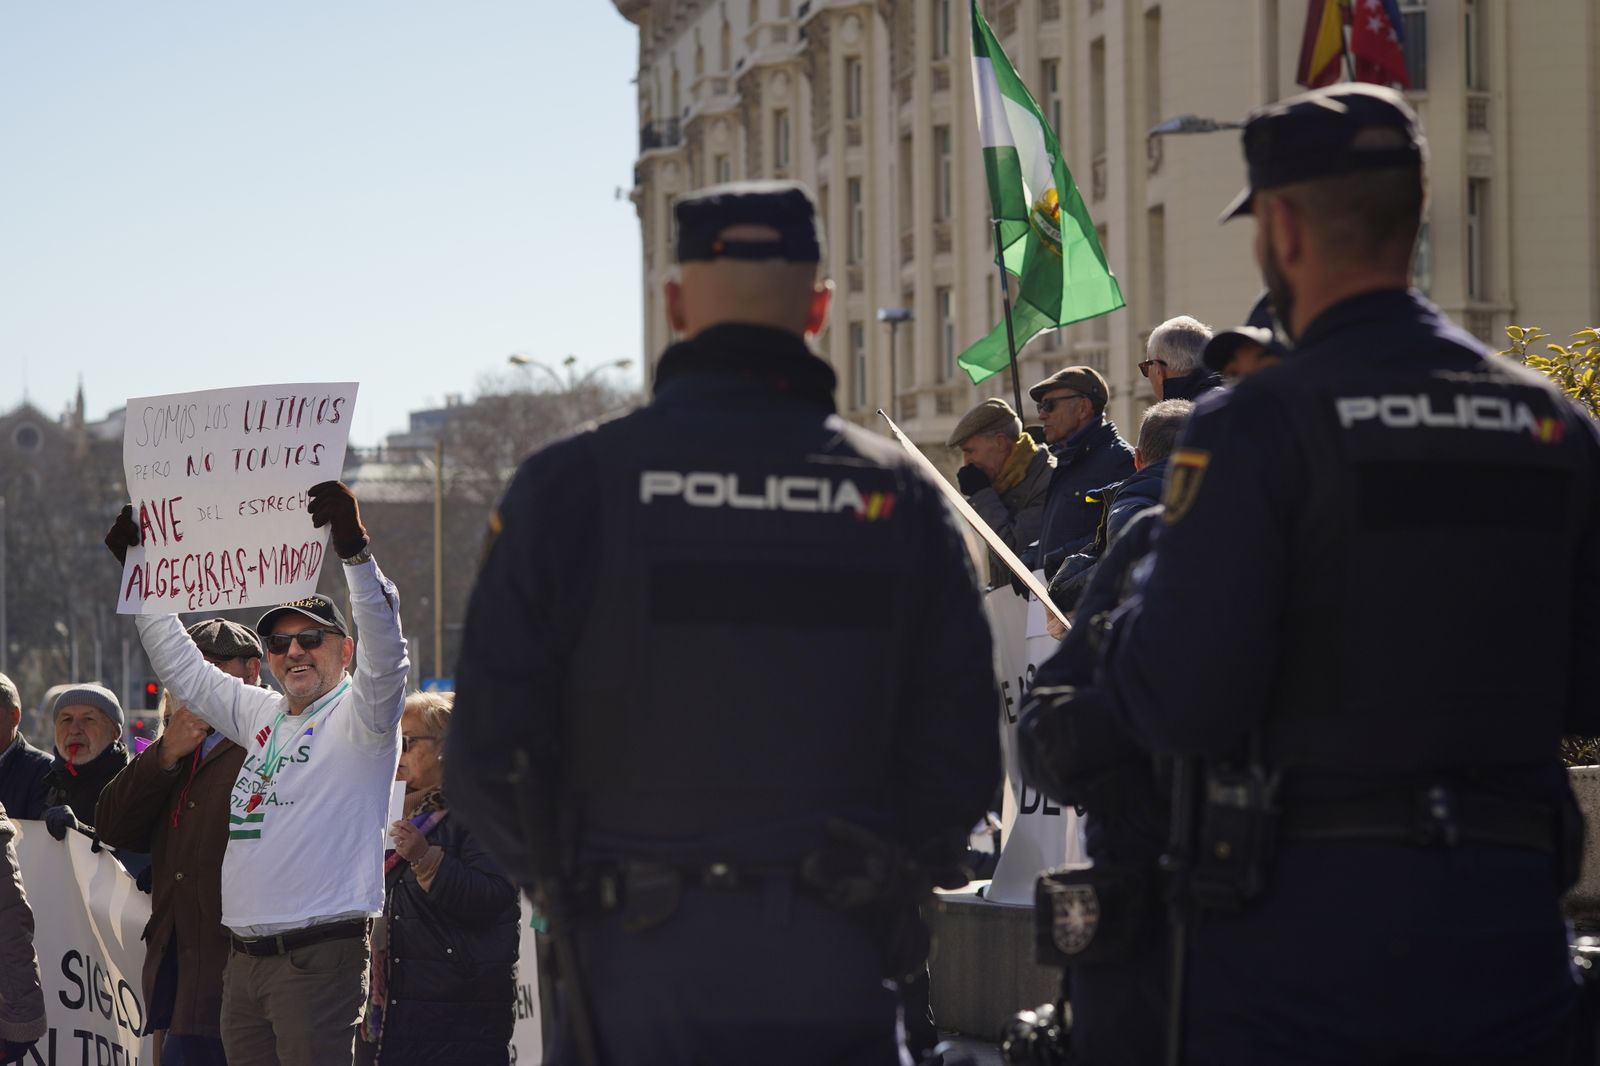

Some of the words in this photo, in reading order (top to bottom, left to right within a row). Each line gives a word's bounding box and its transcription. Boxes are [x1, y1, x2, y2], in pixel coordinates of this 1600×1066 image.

[136, 403, 197, 448] SOMOS
[204, 403, 231, 431] LOS
[244, 395, 345, 434] ULTIMOS
[1336, 394, 1541, 436] POLICIA
[135, 461, 170, 480] PERO
[187, 450, 215, 477] NO
[232, 443, 325, 473] TONTOS
[640, 470, 866, 514] POLICIA
[139, 496, 184, 546] AVE
[198, 504, 224, 522] DEL
[239, 490, 312, 516] ESTRECH
[188, 589, 249, 611] CEUTA
[58, 949, 143, 1038] SIGLO
